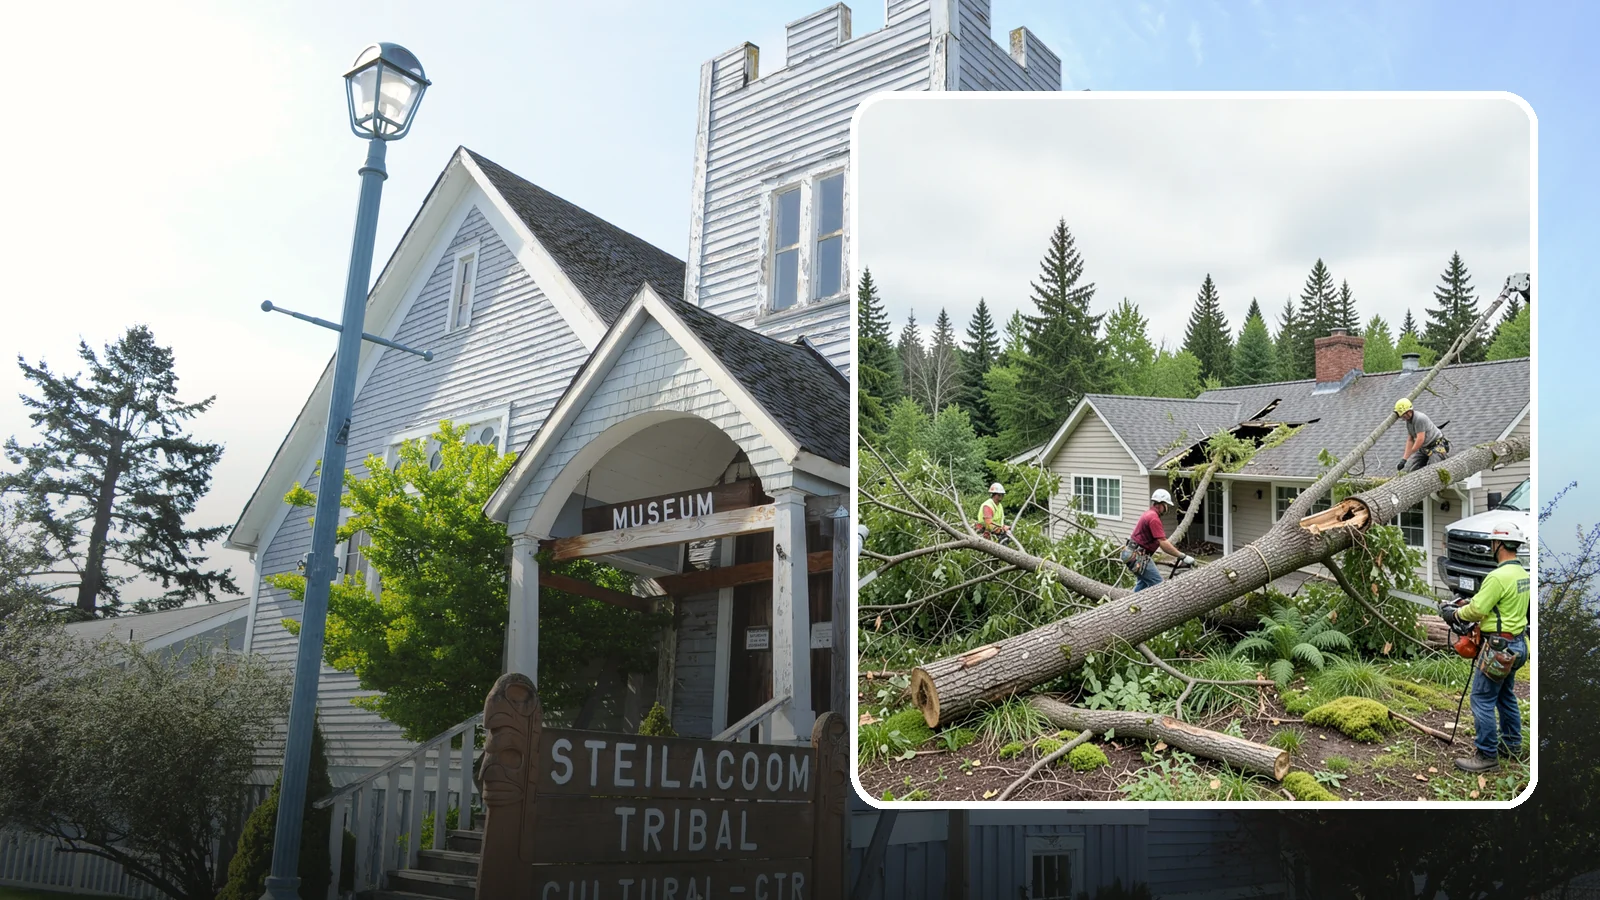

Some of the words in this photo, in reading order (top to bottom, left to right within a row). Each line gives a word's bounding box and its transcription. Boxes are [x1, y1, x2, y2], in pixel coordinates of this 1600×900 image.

[613, 491, 713, 530] MUSEUM
[550, 738, 810, 792] STEILACOOM
[615, 806, 758, 851] TRIBAL
